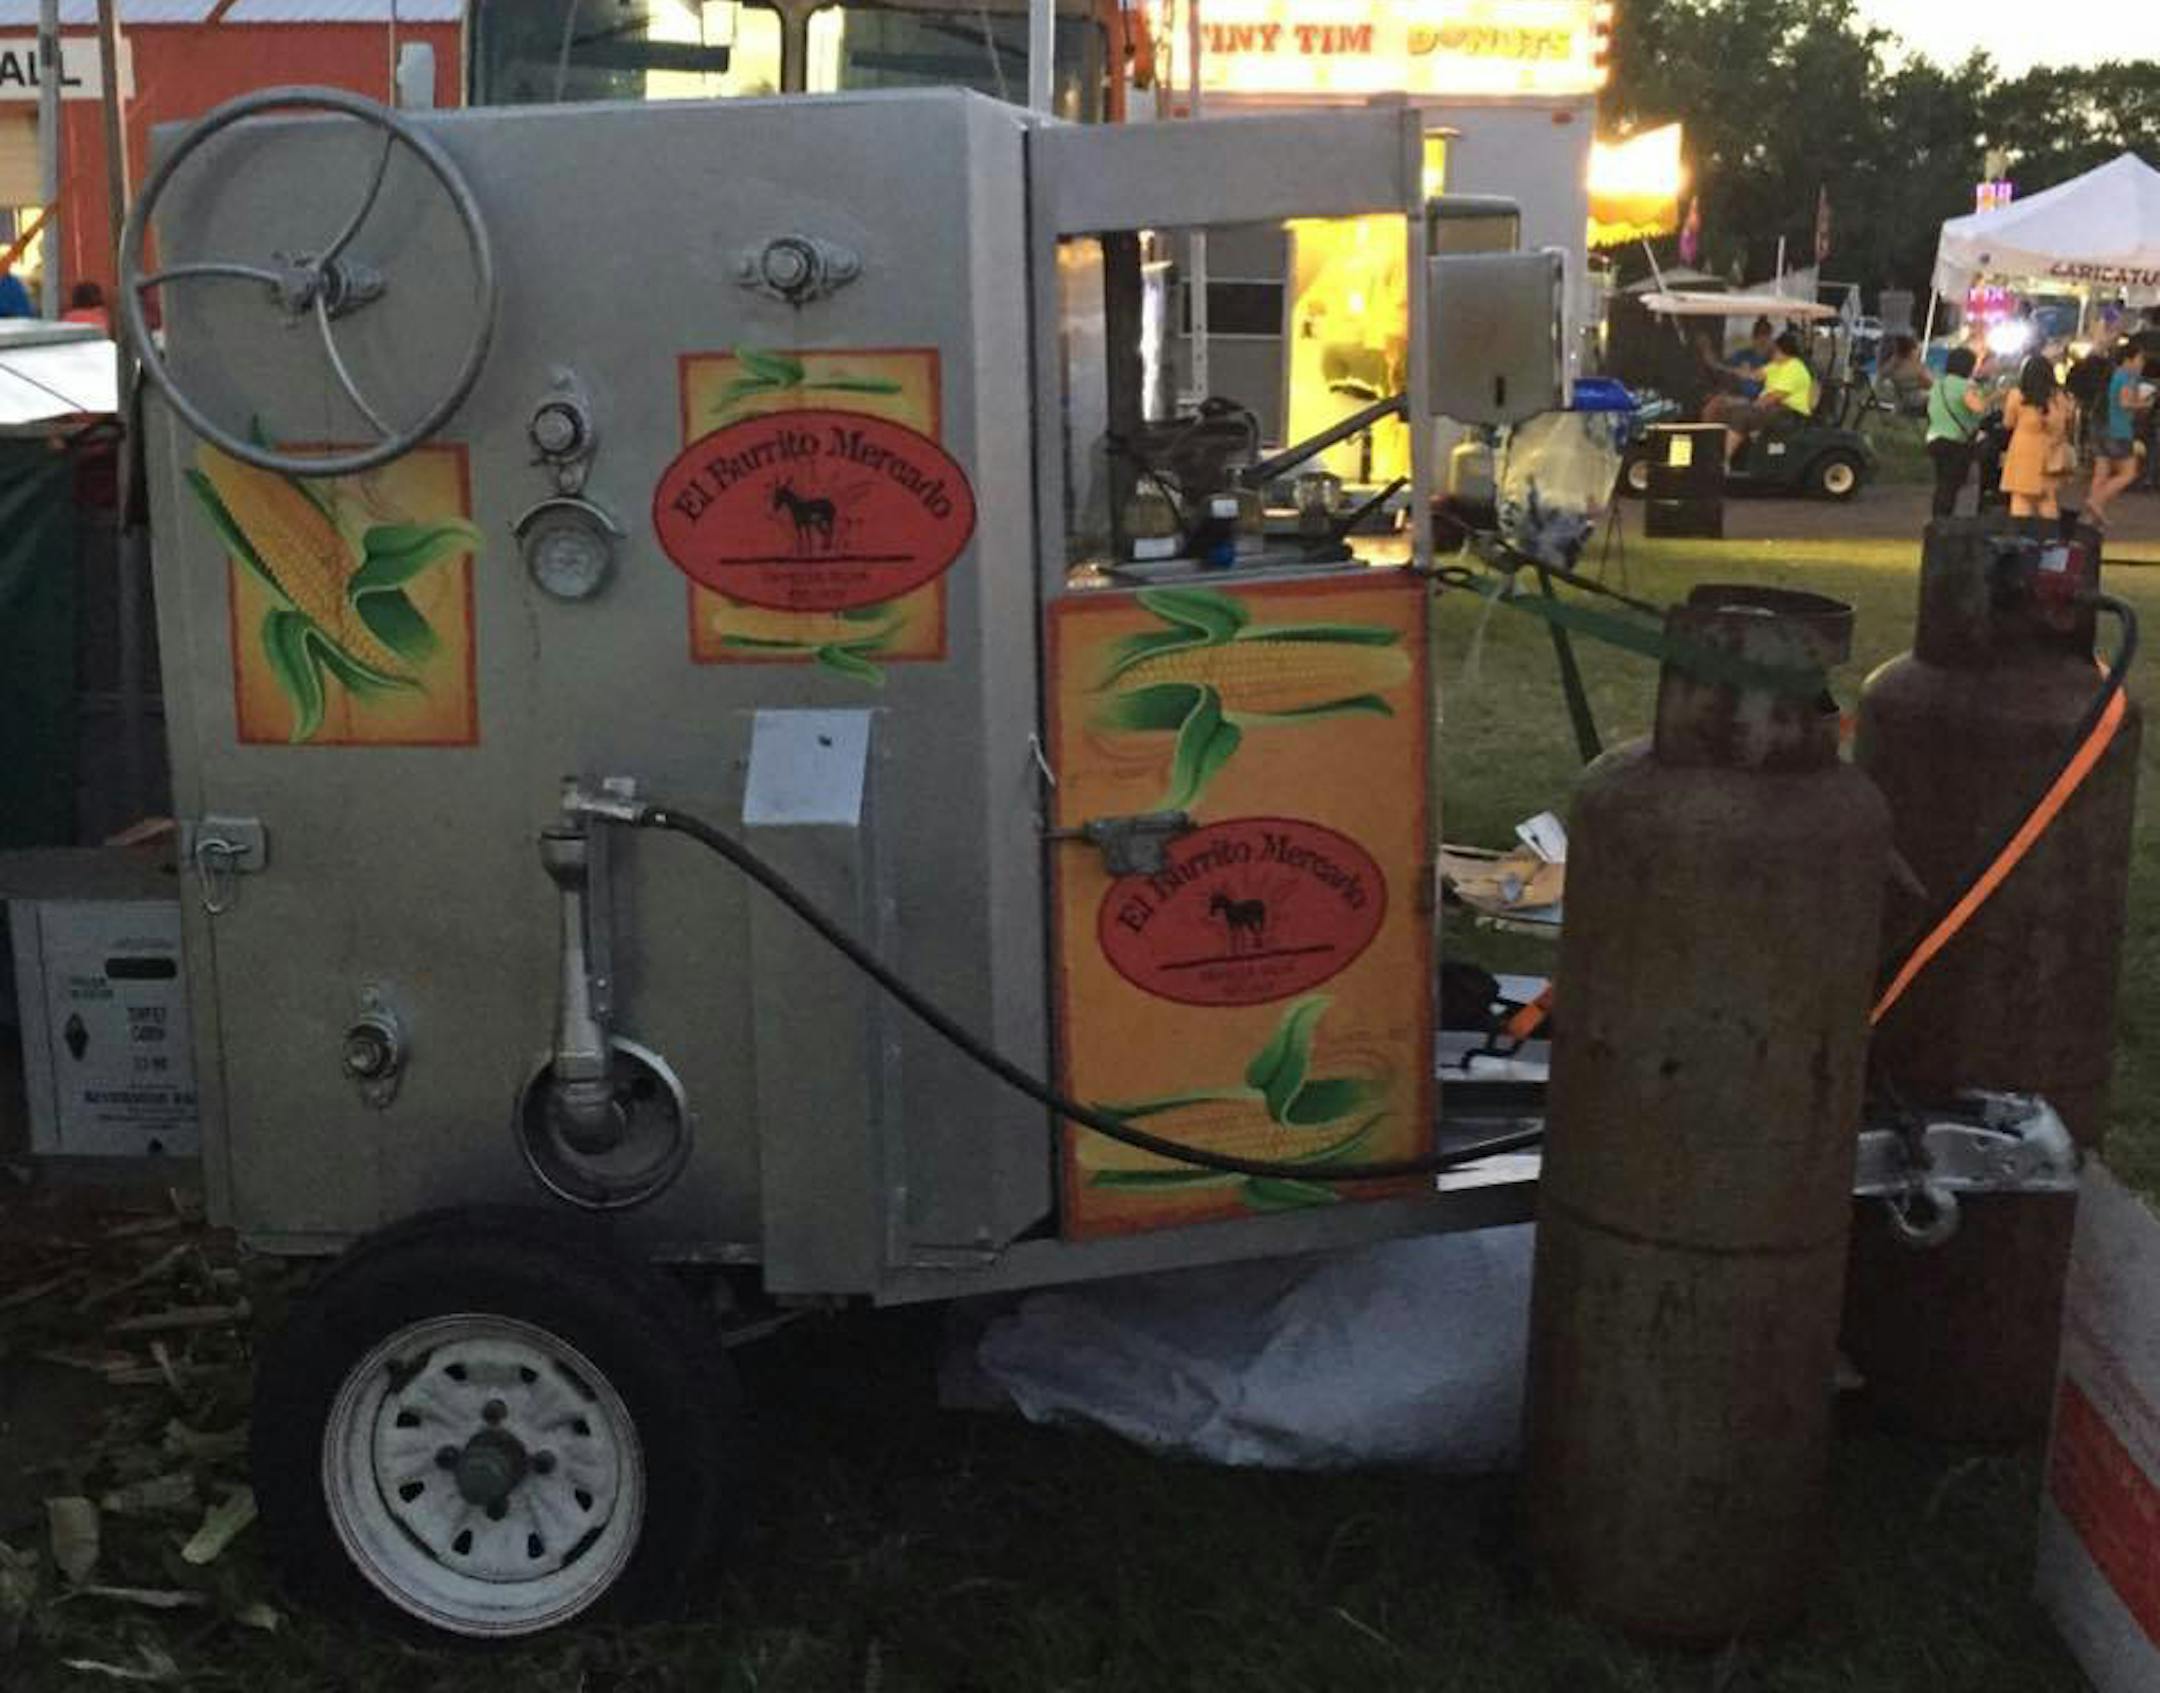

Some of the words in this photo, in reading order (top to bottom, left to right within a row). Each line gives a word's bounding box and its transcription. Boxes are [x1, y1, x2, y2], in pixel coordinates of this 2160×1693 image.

[1293, 22, 1373, 54] TIM
[674, 480, 714, 521] El
[706, 428, 820, 493] Burrito
[826, 426, 953, 520] Mercado
[1117, 895, 1155, 932] El
[1259, 832, 1368, 912] Mercado
